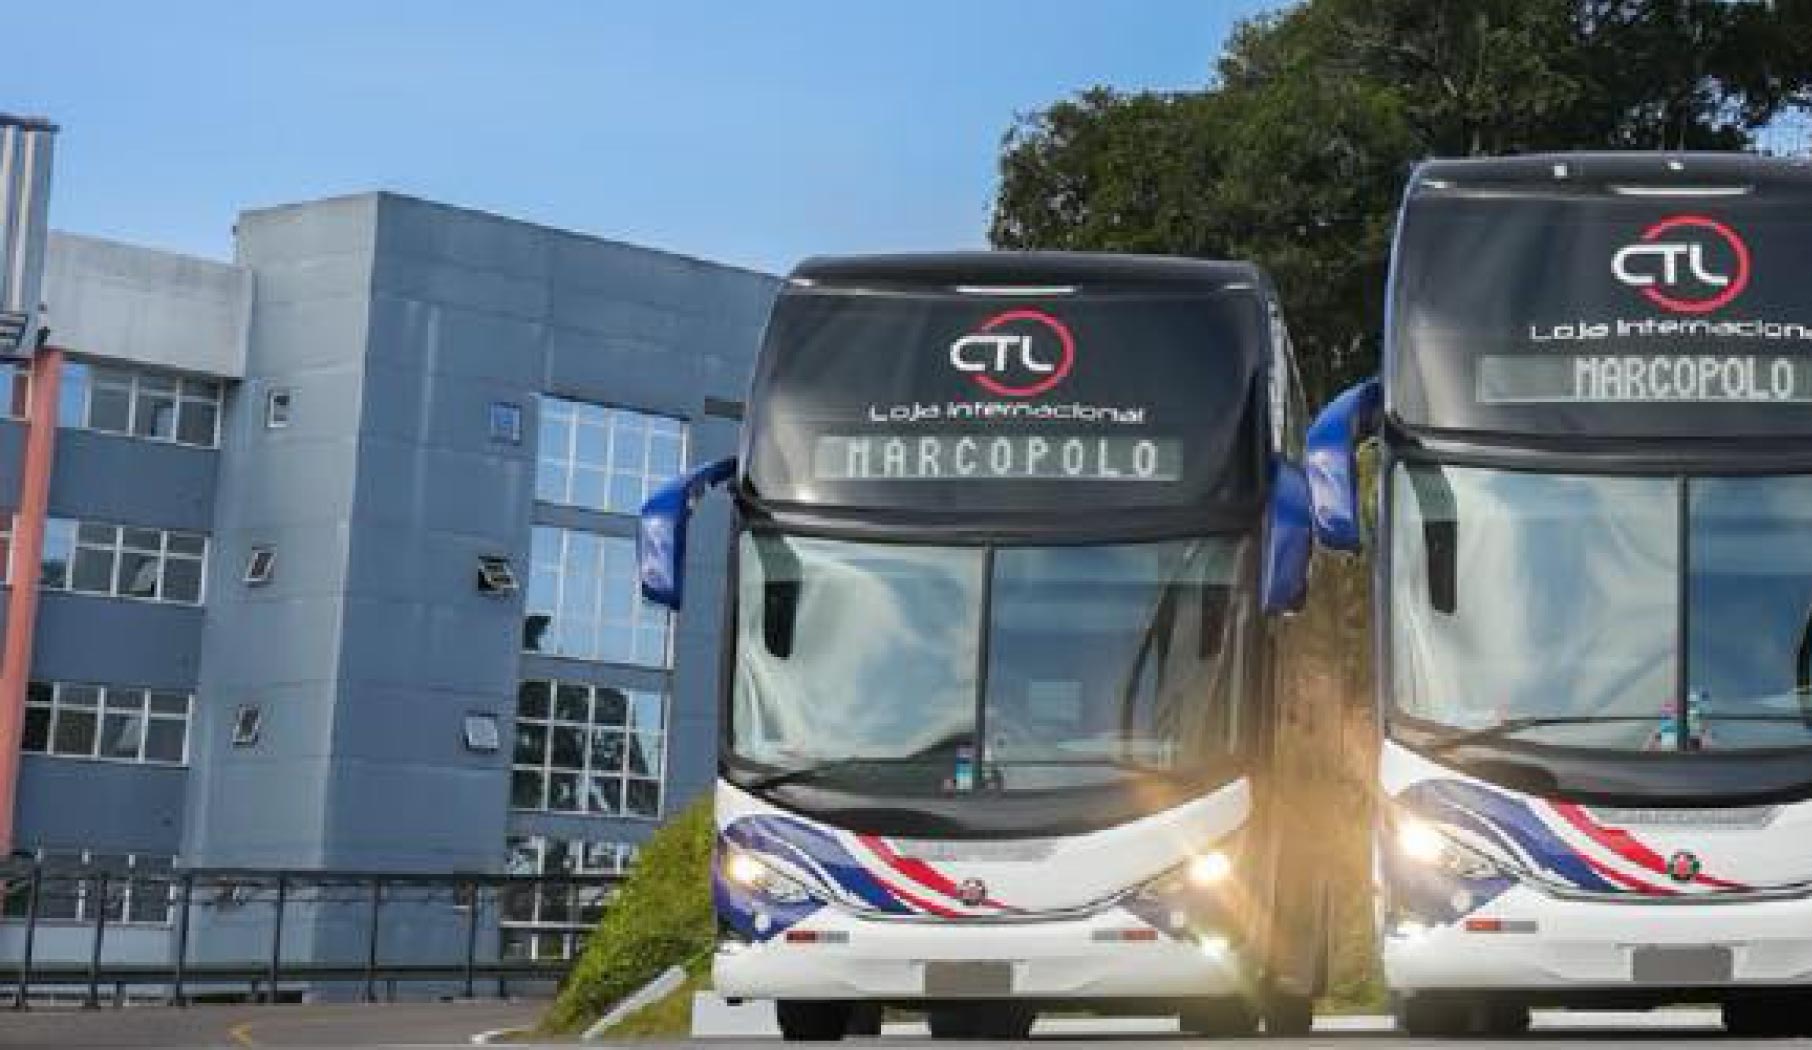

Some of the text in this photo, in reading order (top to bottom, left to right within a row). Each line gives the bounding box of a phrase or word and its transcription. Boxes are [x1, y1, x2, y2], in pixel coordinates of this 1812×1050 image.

[1610, 242, 1729, 285] CTL
[1529, 320, 1609, 340] Loja
[949, 335, 1054, 372] CTL
[1574, 355, 1795, 399] MARCOPOLO
[848, 436, 1159, 479] MARCOPOLO
